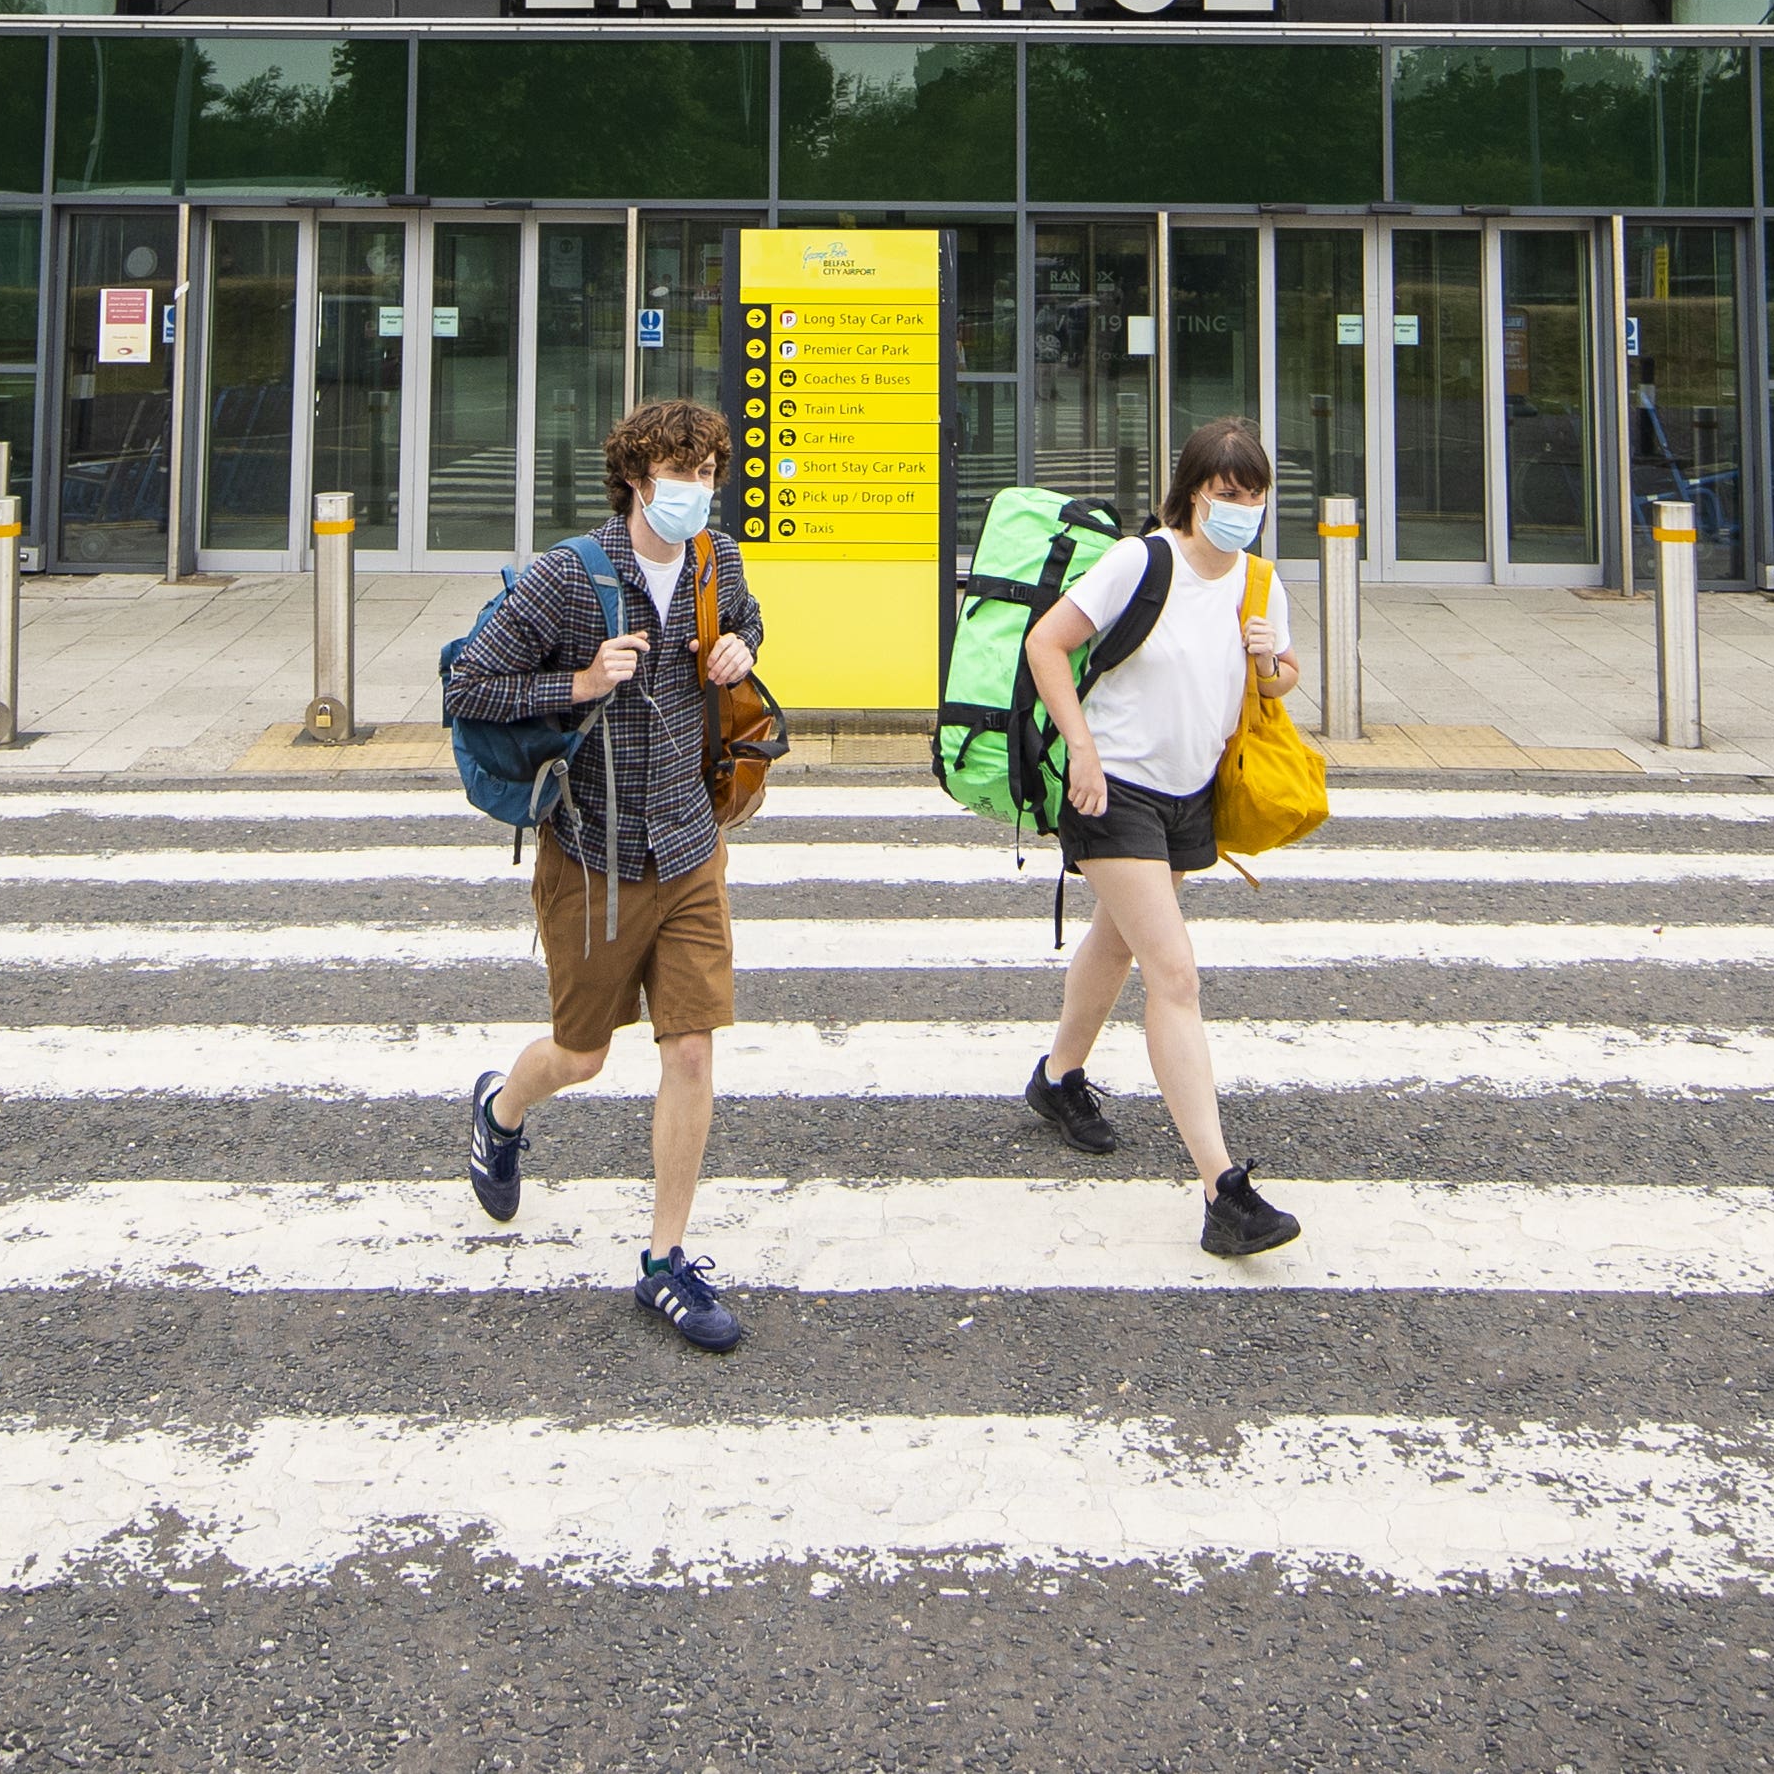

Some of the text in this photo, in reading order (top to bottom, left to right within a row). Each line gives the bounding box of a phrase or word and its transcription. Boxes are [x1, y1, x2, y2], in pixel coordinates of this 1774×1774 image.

[1050, 271, 1114, 282] RANX
[804, 314, 835, 327] Long
[840, 314, 866, 327] Stay
[871, 314, 891, 324] Car
[896, 314, 923, 324] Park
[804, 344, 851, 355] Premier
[856, 345, 877, 355] Car
[882, 345, 909, 355] Park
[804, 373, 911, 385] Coaches & Buses
[804, 403, 865, 414] Train Link
[803, 433, 855, 443] Car Hire
[803, 462, 836, 472] Short
[842, 462, 868, 475] Stay
[873, 462, 893, 473] Car
[898, 462, 926, 473] Park
[802, 491, 827, 502] Pick
[833, 494, 849, 505] up
[861, 492, 893, 505] Drop
[897, 491, 915, 503] off
[804, 522, 834, 533] Taxis
